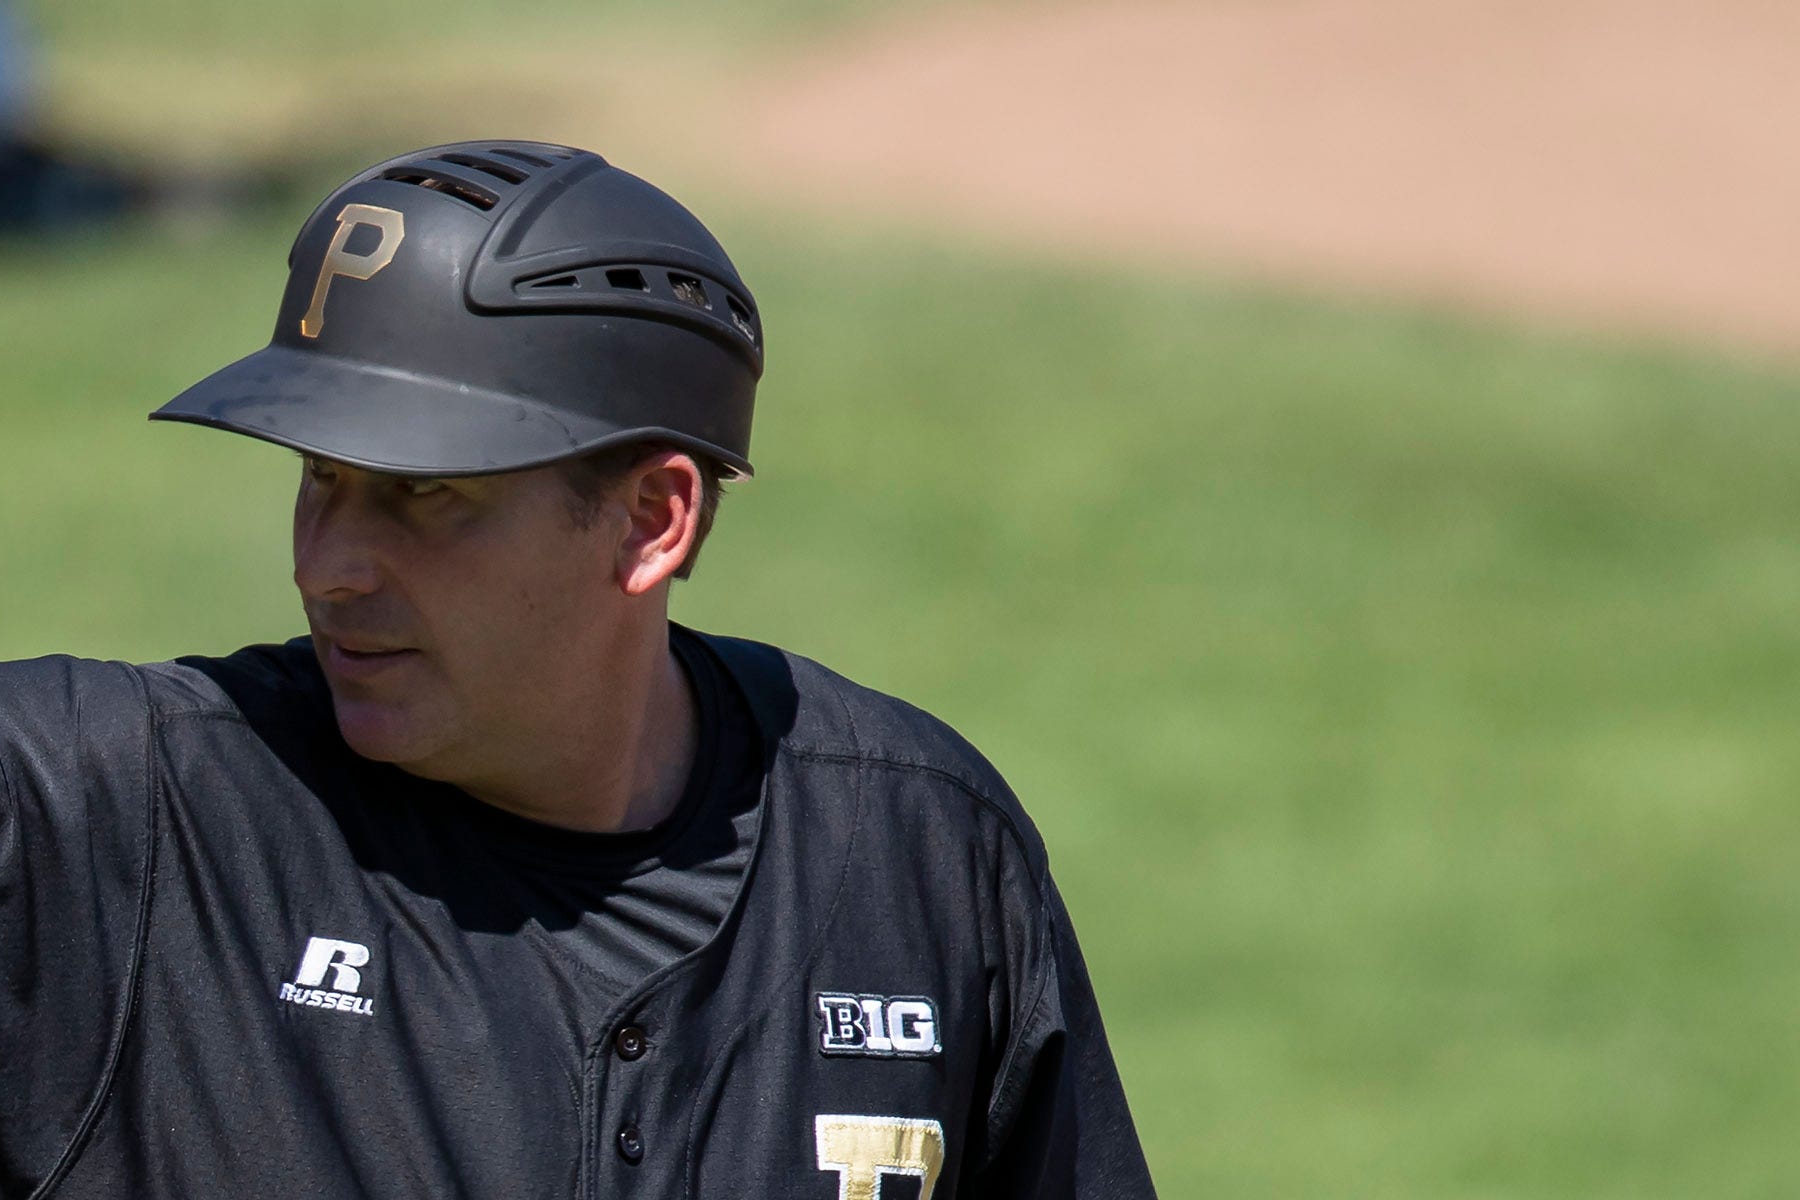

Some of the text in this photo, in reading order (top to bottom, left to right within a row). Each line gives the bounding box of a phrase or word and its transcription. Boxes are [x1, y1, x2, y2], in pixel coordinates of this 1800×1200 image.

[301, 203, 405, 338] P
[295, 936, 370, 994] R
[279, 982, 374, 1016] RUSSELL
